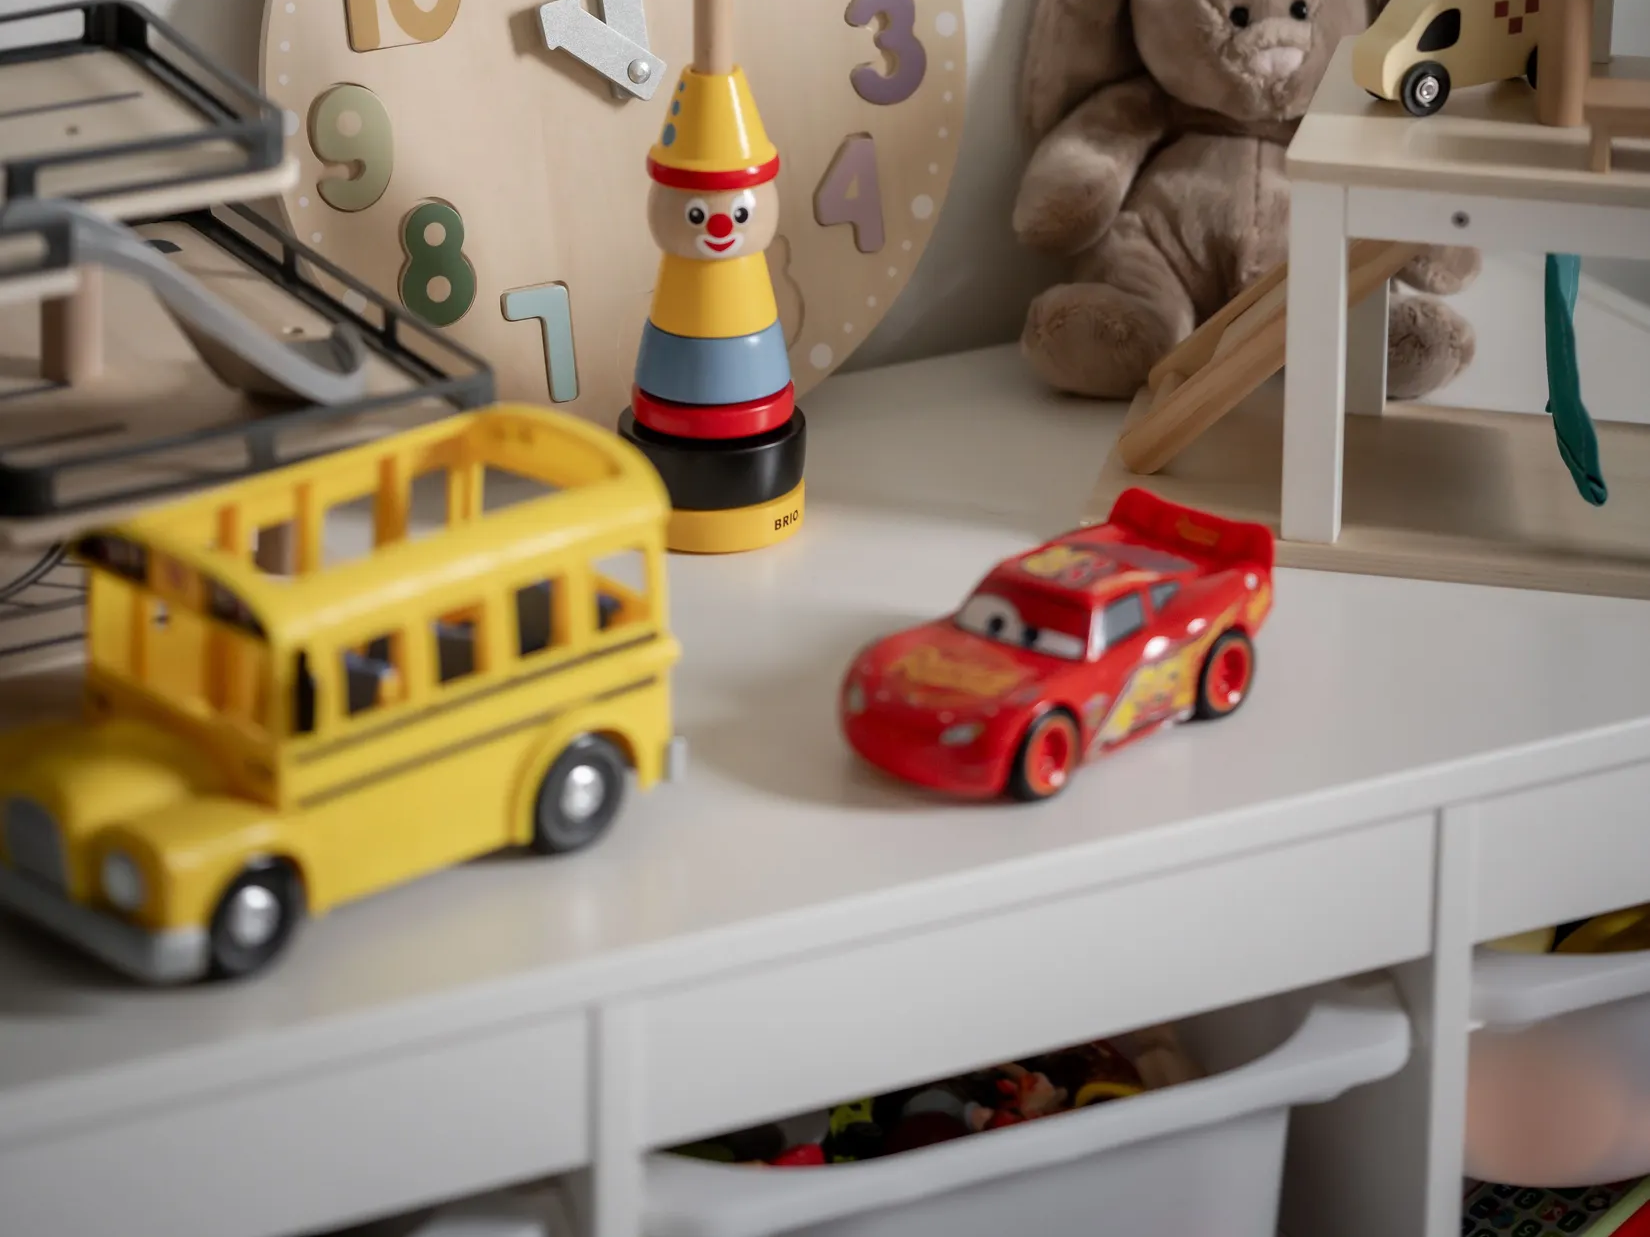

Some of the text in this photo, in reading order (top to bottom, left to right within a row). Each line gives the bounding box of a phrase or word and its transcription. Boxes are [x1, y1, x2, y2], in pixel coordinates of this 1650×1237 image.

[308, 84, 392, 211] 9
[815, 136, 884, 252] 4
[401, 202, 475, 326] 8
[501, 283, 578, 402] 7
[775, 510, 798, 530] BRIO
